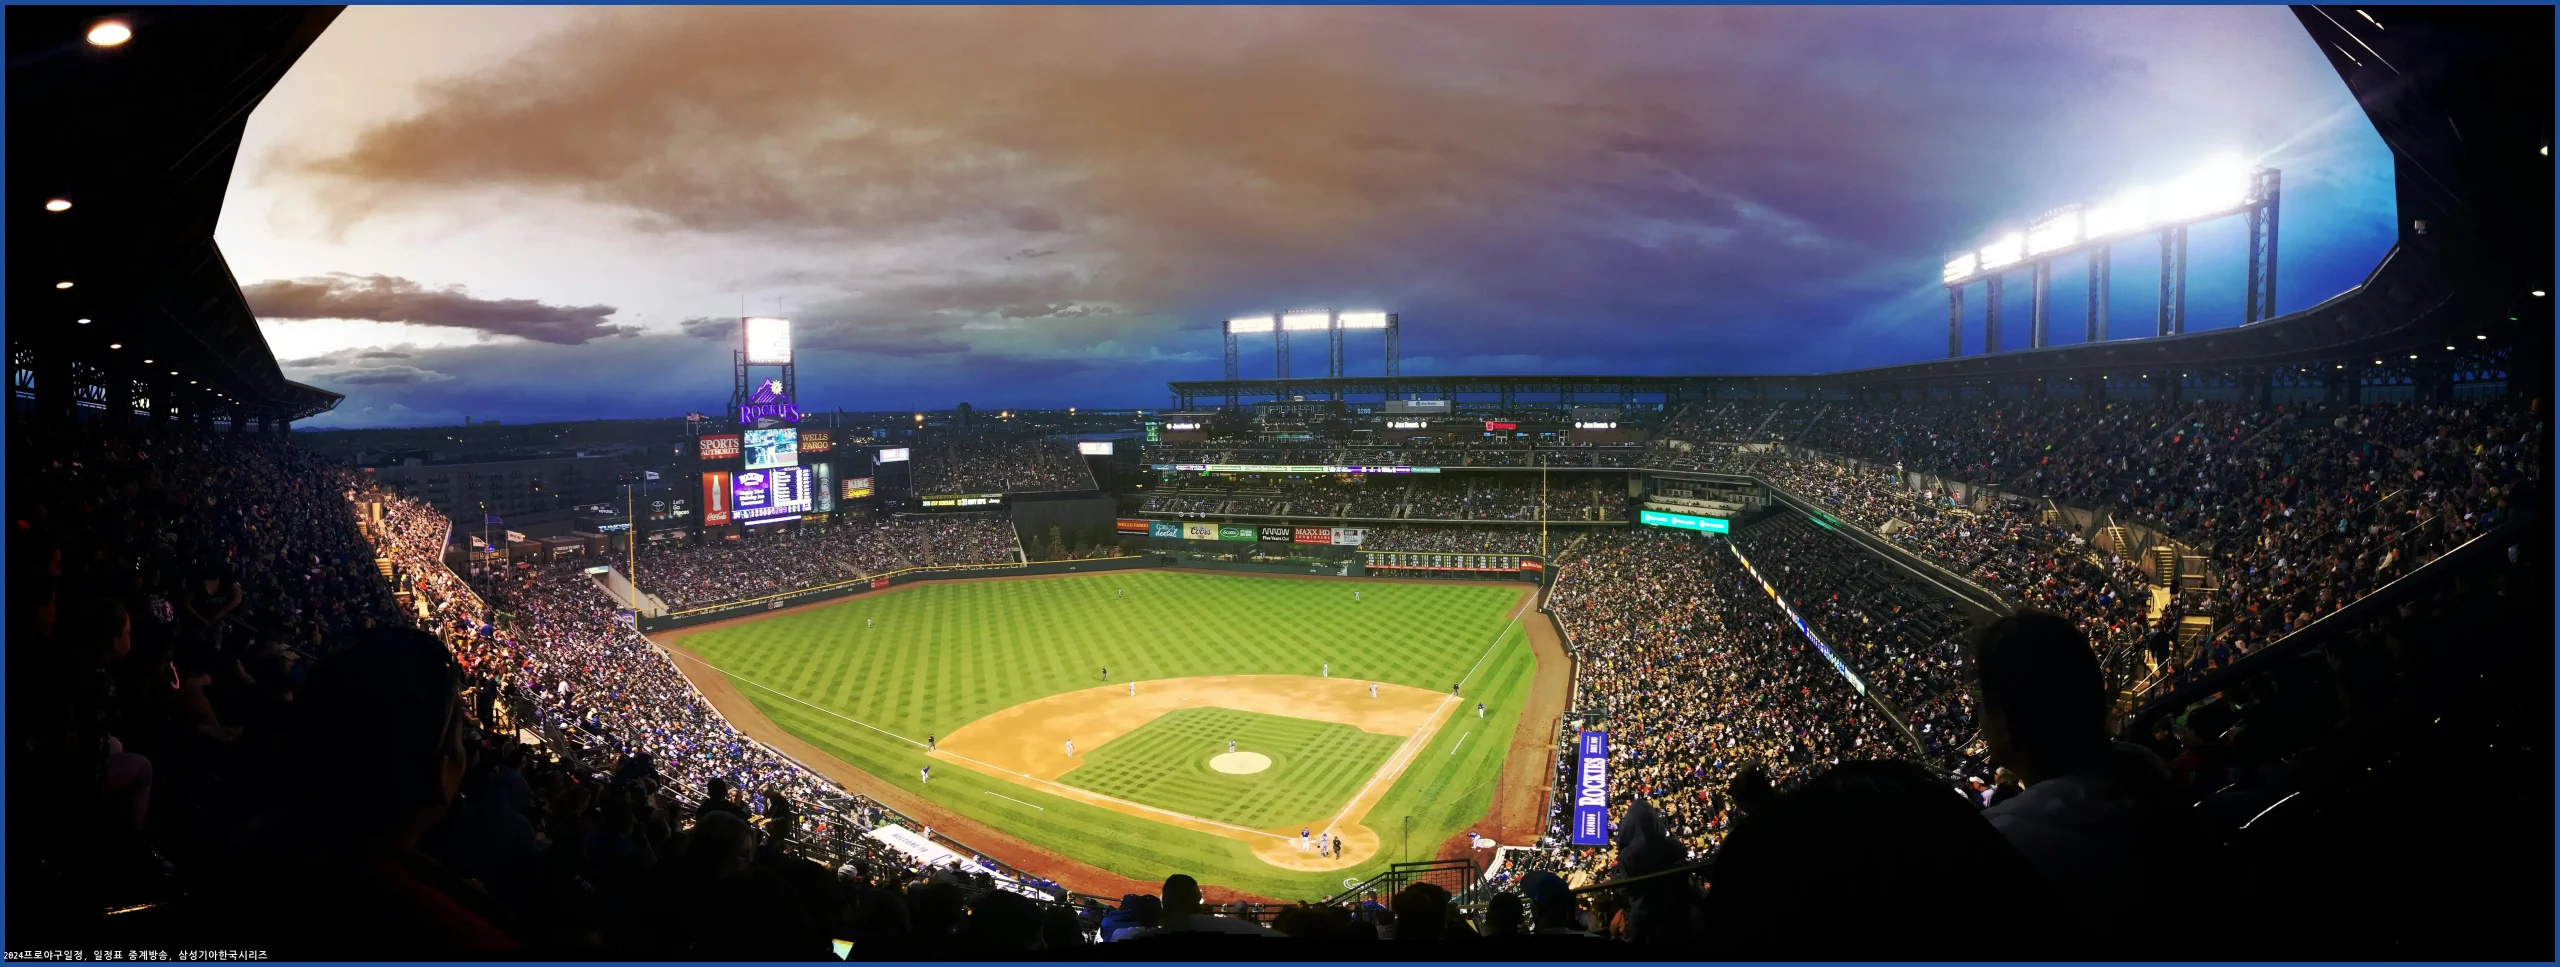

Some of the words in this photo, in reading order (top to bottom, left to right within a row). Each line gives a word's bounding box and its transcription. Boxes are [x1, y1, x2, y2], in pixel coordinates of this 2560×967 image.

[738, 402, 800, 425] ROCKIES
[700, 437, 740, 449] SPORTS
[802, 433, 829, 442] WELLS
[701, 447, 740, 456] AUTHORITY
[802, 441, 829, 450] FARGO
[1578, 757, 1606, 807] ROCKIES
[1586, 813, 1596, 835] COLORADO
[892, 833, 920, 849] WELCOME
